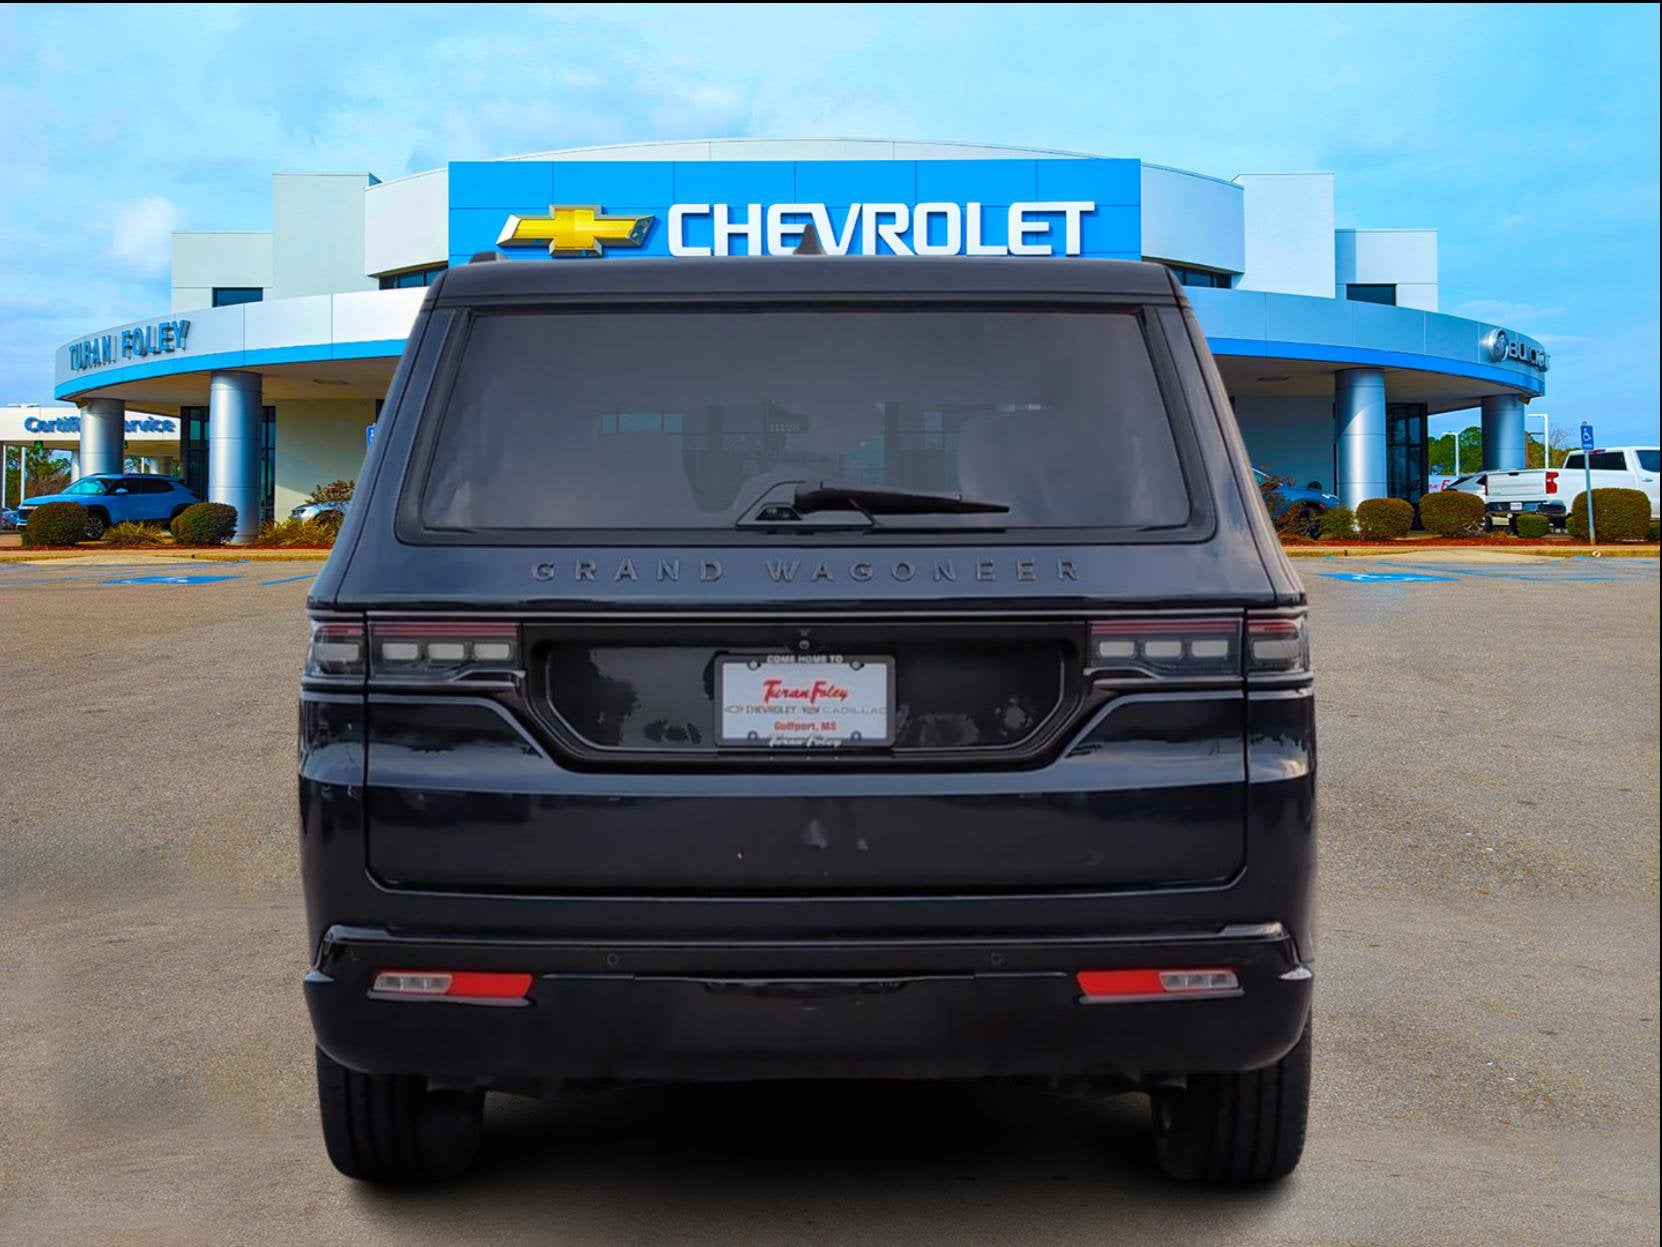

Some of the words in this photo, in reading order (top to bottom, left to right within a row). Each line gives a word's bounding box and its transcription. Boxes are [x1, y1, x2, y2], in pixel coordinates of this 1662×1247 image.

[668, 201, 1095, 257] CHEVROLET
[69, 334, 117, 372] TURAN
[121, 319, 190, 360] FOLEY
[24, 416, 81, 433] Certifi
[124, 415, 175, 433] ervice
[532, 559, 724, 583] GRAND
[766, 558, 1080, 583] WAGONEER
[767, 655, 796, 664] COME
[797, 655, 827, 664] HOME
[829, 655, 844, 664] TO
[763, 679, 809, 704] Turan
[809, 680, 849, 704] Foley
[745, 705, 796, 715] CHEVROLET
[822, 705, 887, 715] CADILLAC
[773, 721, 819, 733] Gulfport,
[820, 721, 838, 732] MS
